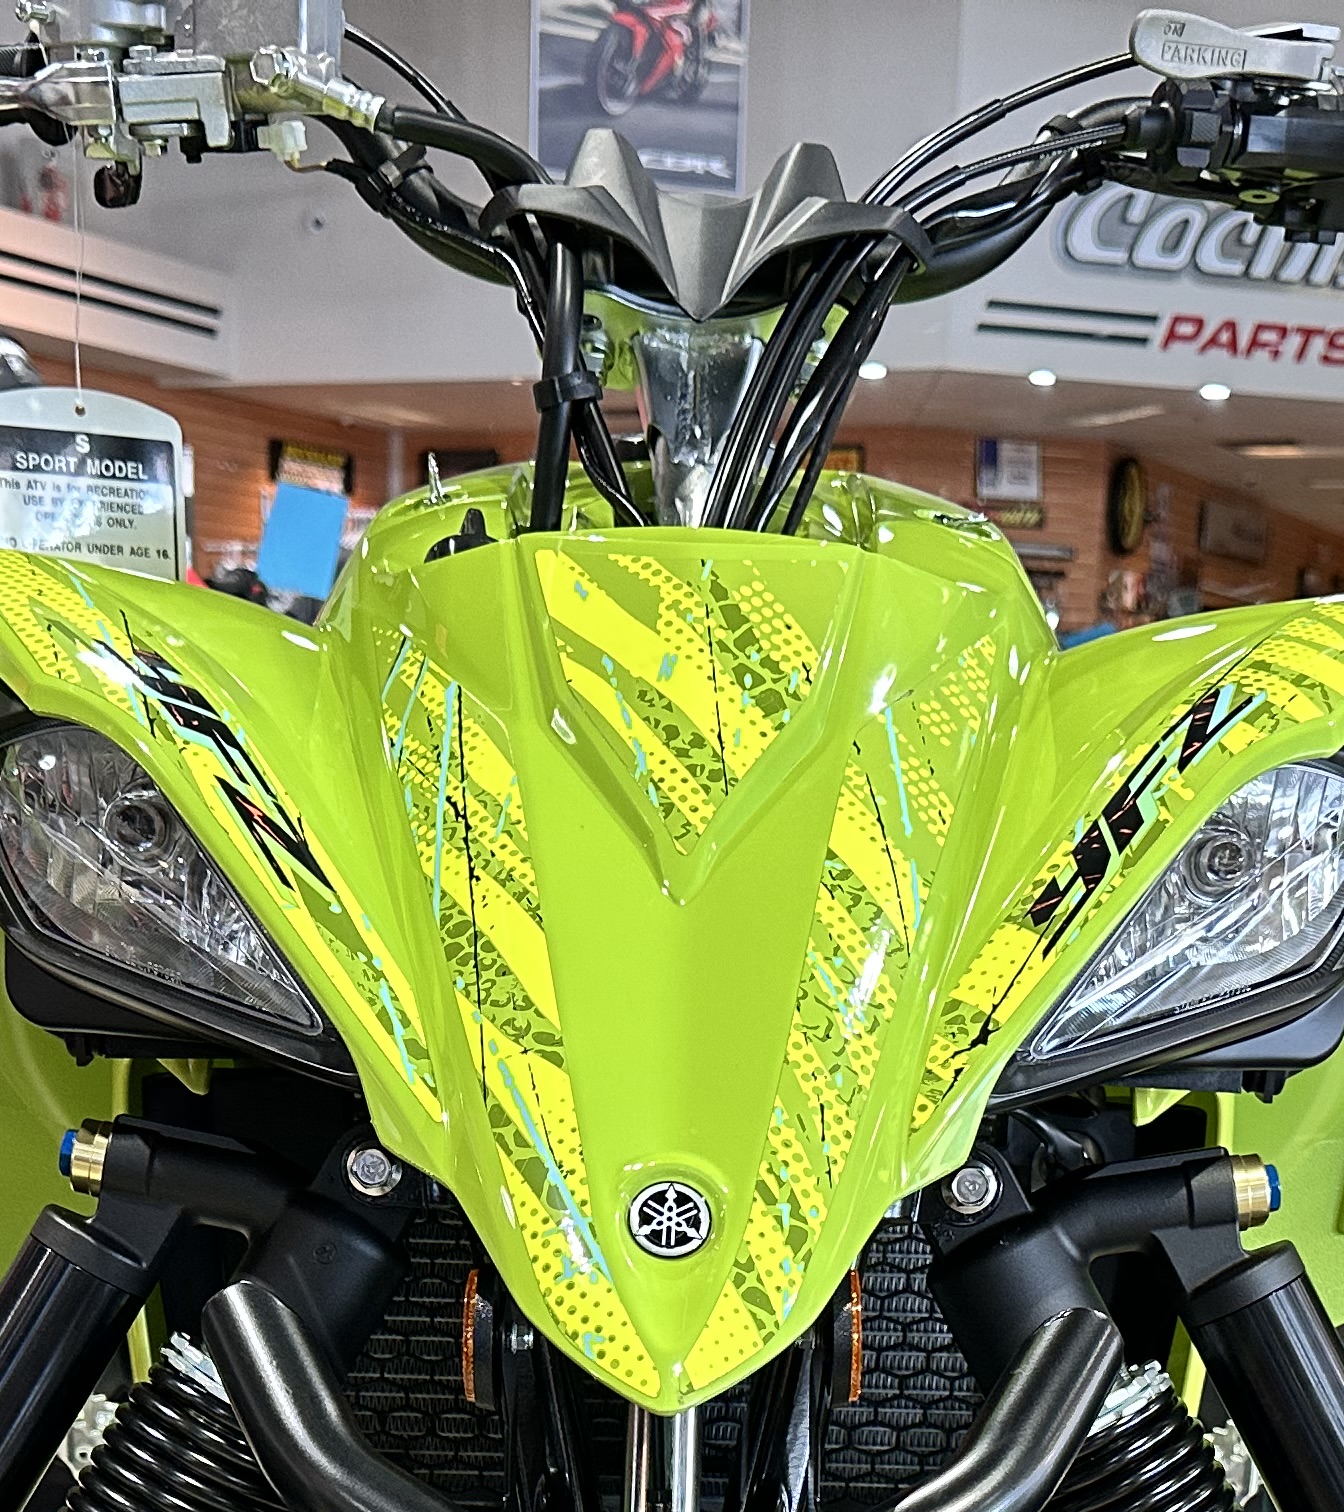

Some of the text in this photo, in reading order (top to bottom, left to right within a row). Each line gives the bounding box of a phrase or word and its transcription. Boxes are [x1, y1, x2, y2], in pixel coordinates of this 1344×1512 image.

[1163, 43, 1245, 68] PARKING
[75, 434, 91, 454] S
[15, 451, 149, 480] SPORT MODEL
[26, 480, 47, 491] ATV
[23, 495, 44, 506] USE
[107, 518, 137, 530] ONLY.
[87, 544, 124, 557] UNDER
[129, 548, 151, 558] AGE
[156, 549, 172, 560] 16.
